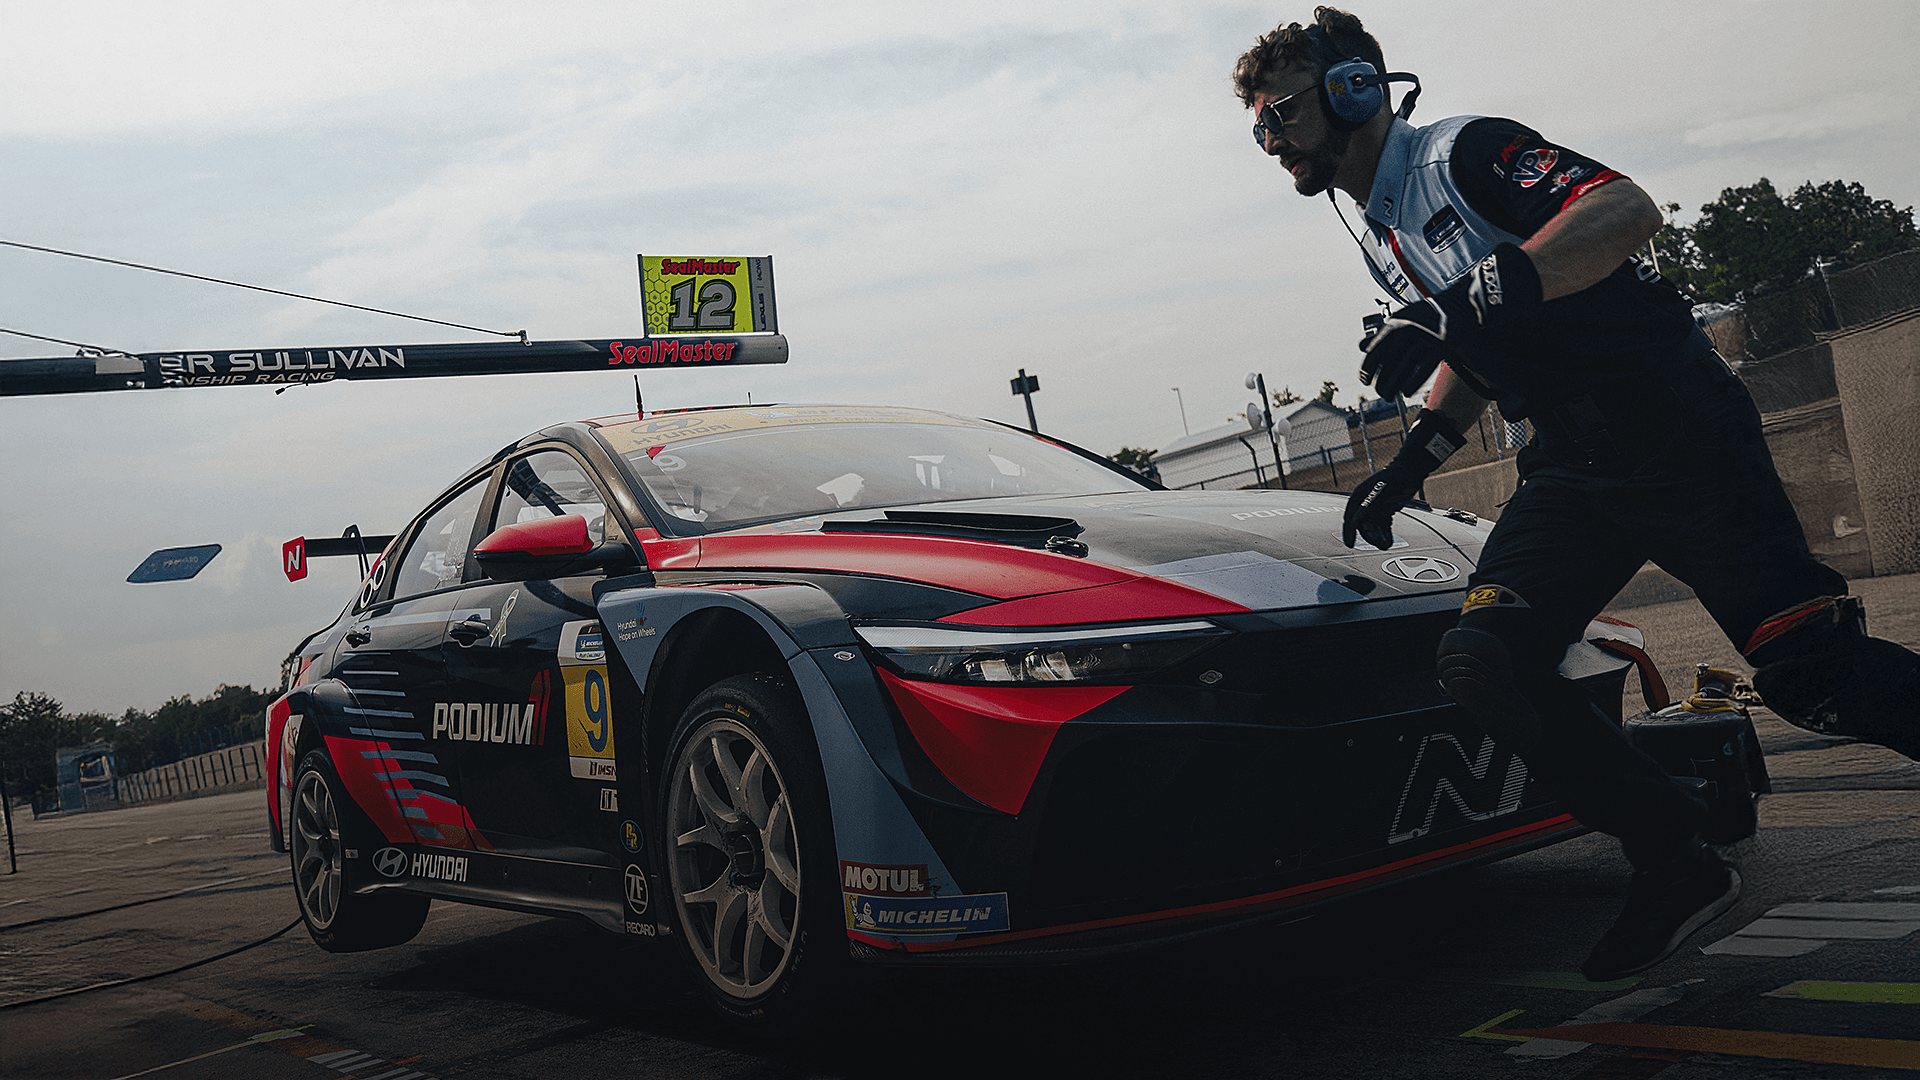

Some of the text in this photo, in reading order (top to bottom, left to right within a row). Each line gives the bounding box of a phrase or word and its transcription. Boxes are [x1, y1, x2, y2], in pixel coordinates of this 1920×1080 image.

[661, 259, 740, 275] SealMaster
[668, 277, 737, 330] 12
[229, 348, 407, 372] SULLIVAN
[608, 340, 735, 364] SealMaster
[255, 371, 336, 384] RACING
[632, 422, 732, 446] HYUNDAI
[617, 619, 637, 631] Hyundai
[618, 631, 632, 642] Hope
[638, 627, 656, 638] Wheels
[584, 669, 608, 752] 9
[411, 853, 469, 883] HYUNDAI
[845, 865, 926, 893] MOTUL
[878, 906, 992, 924] MICHELIN
[626, 921, 656, 938] RECARO
